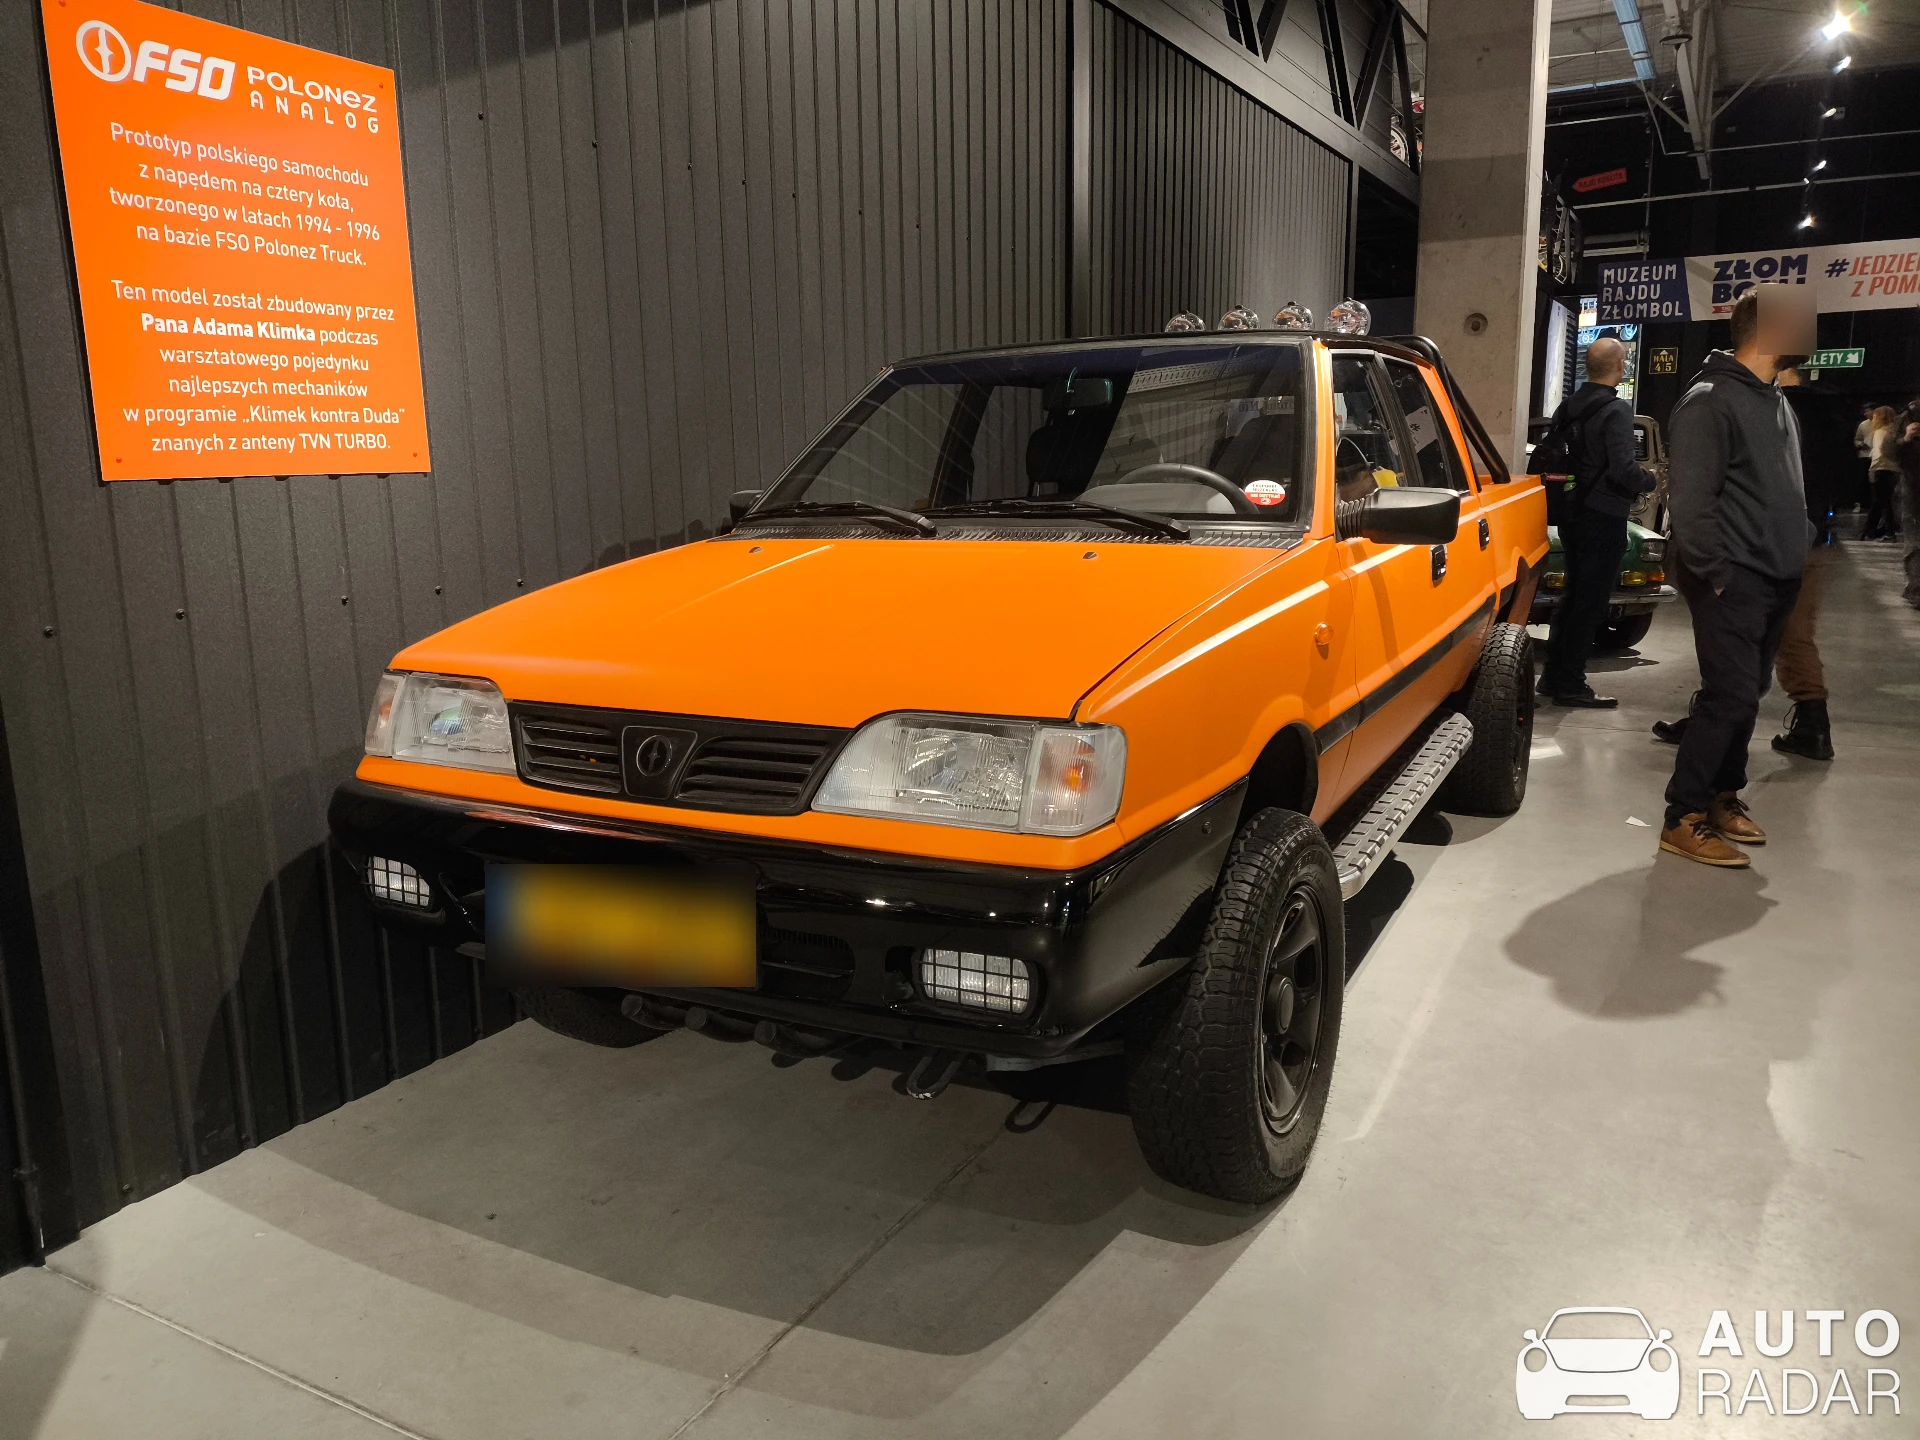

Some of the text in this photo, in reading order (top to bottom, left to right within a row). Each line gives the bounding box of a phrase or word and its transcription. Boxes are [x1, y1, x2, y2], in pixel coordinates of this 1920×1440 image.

[133, 41, 236, 100] FSO
[250, 91, 378, 134] ANALOG
[111, 122, 368, 187] Prototyp polskiego samochodu
[139, 164, 354, 213] z napędem na cztery koła,
[109, 187, 218, 222] tworzonego
[223, 208, 237, 221] w
[242, 206, 291, 228] latach
[296, 214, 332, 234] 1994
[347, 221, 380, 240] 1996
[137, 224, 366, 265] na bazie FSO Polonez Truck.
[1603, 264, 1677, 284] MUZEUM
[1713, 254, 1808, 281] ZŁOM
[1825, 252, 1920, 277] #JEDZIE
[1602, 284, 1660, 302] RAJDU
[1869, 274, 1920, 296] POM
[111, 280, 394, 322] Ten model został zbudowany przez
[1602, 301, 1683, 319] ZŁOMBOL
[142, 313, 378, 345] Pana Adama Klimka podczas
[160, 349, 369, 373] warsztatowego pojedynku
[169, 376, 368, 398] najlepszych mechaników
[123, 408, 139, 421] w
[145, 409, 236, 427] programie
[311, 407, 359, 422] kontra
[152, 434, 390, 455] znanych z anteny TVN TURBO.
